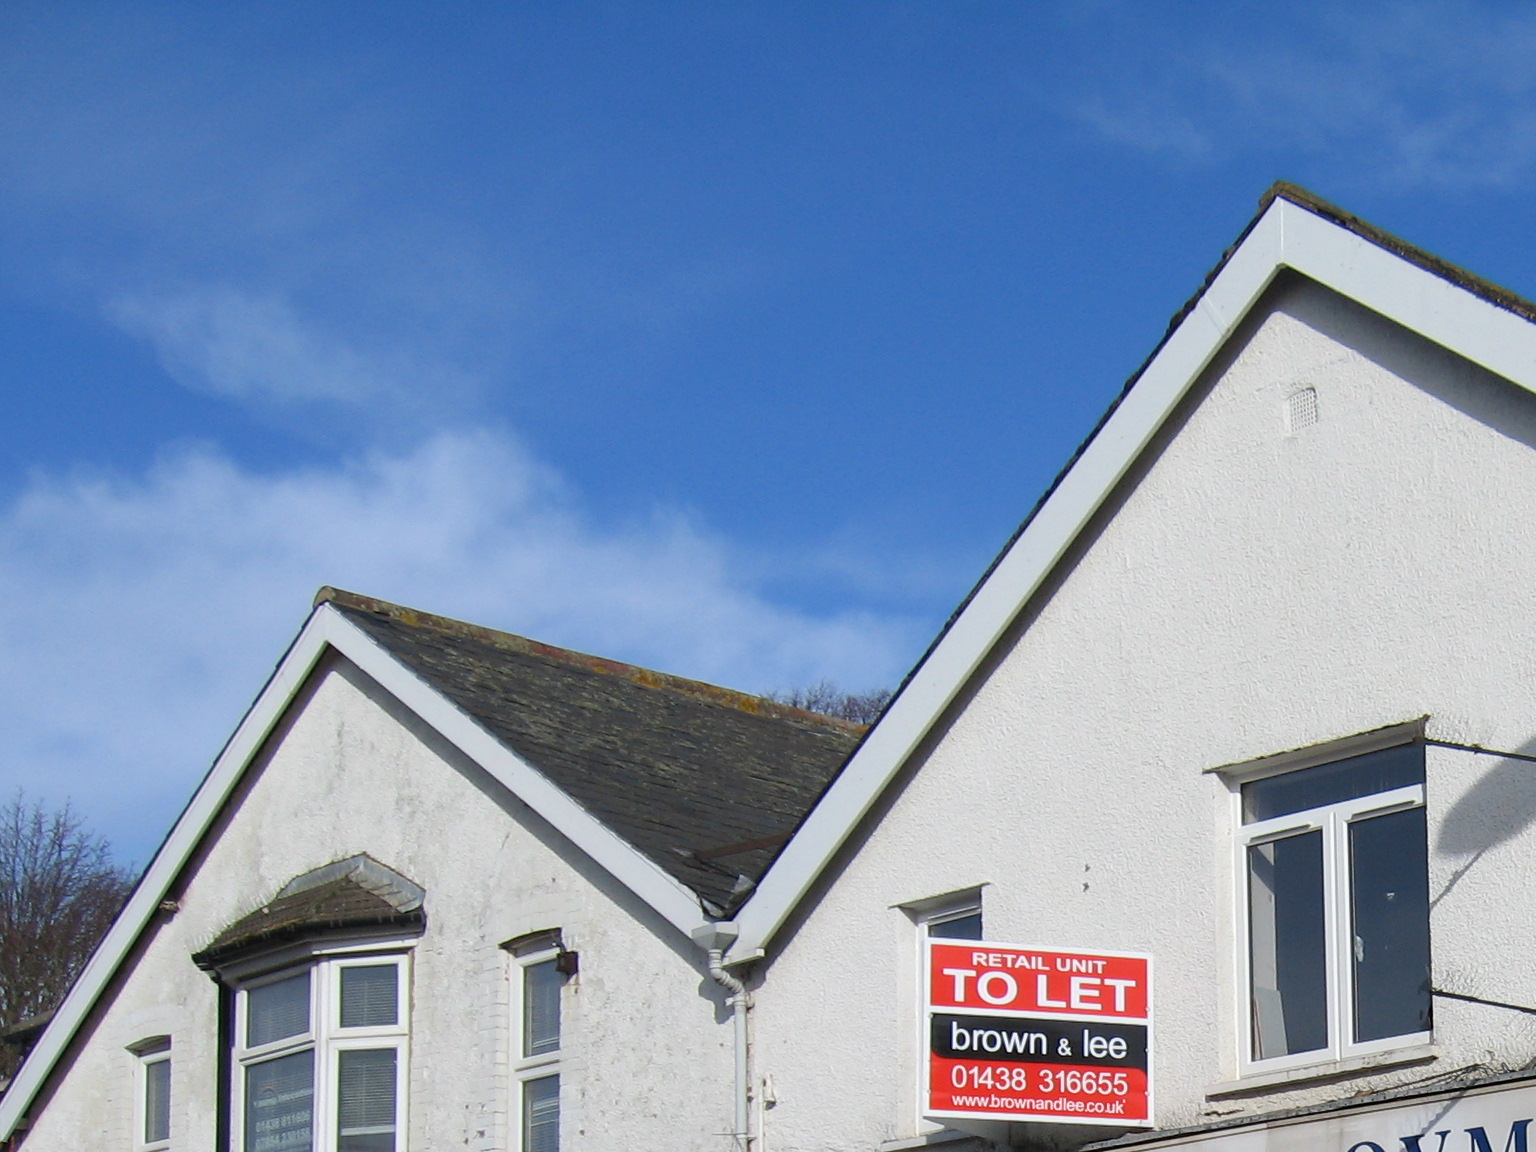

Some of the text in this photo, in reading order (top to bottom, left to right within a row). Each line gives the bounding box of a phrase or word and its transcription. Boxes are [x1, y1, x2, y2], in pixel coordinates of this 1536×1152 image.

[972, 952, 1107, 974] RETAIL UNIT
[943, 968, 1136, 1012] TO LET
[951, 1021, 1127, 1059] brown & lee
[951, 1065, 1128, 1096] 01438 316655
[952, 1094, 1126, 1115] www.brownandlee.co.uk
